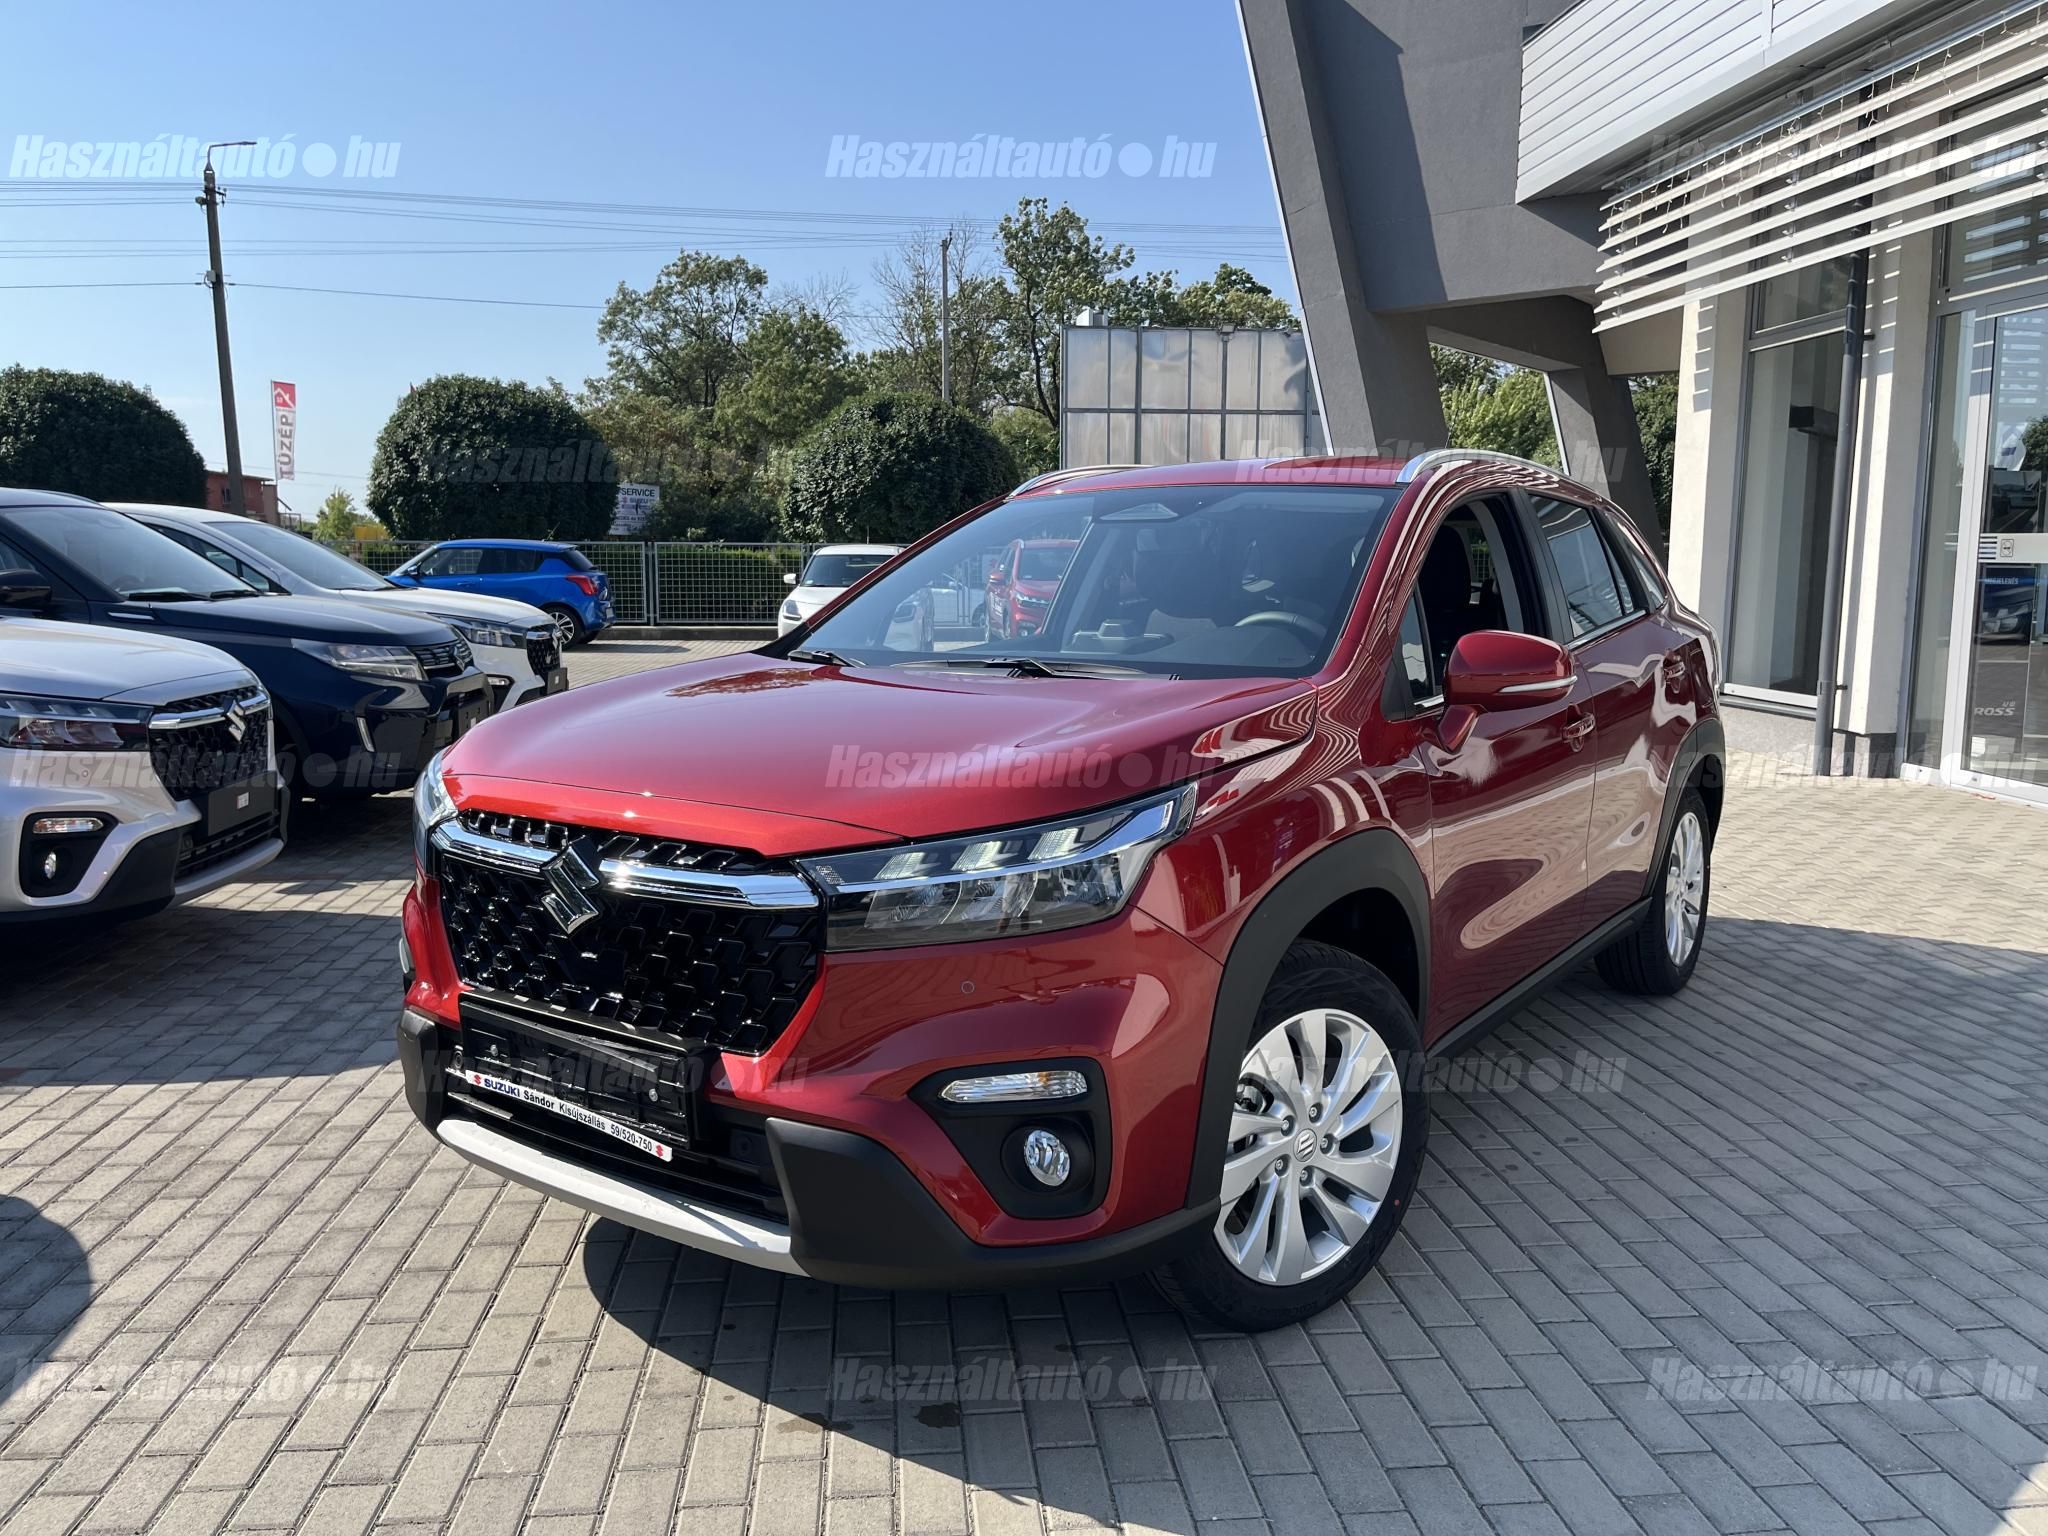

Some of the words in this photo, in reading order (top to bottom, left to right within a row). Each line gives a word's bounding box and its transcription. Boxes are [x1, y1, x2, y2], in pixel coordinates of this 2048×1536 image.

[277, 414, 294, 480] TÜZÉP
[621, 488, 656, 497] SERVICE
[484, 1077, 520, 1097] SUZUKI
[523, 1089, 554, 1110] Sándor
[559, 1101, 606, 1131] Kisújszállás
[610, 1124, 653, 1152] 59/520-750
